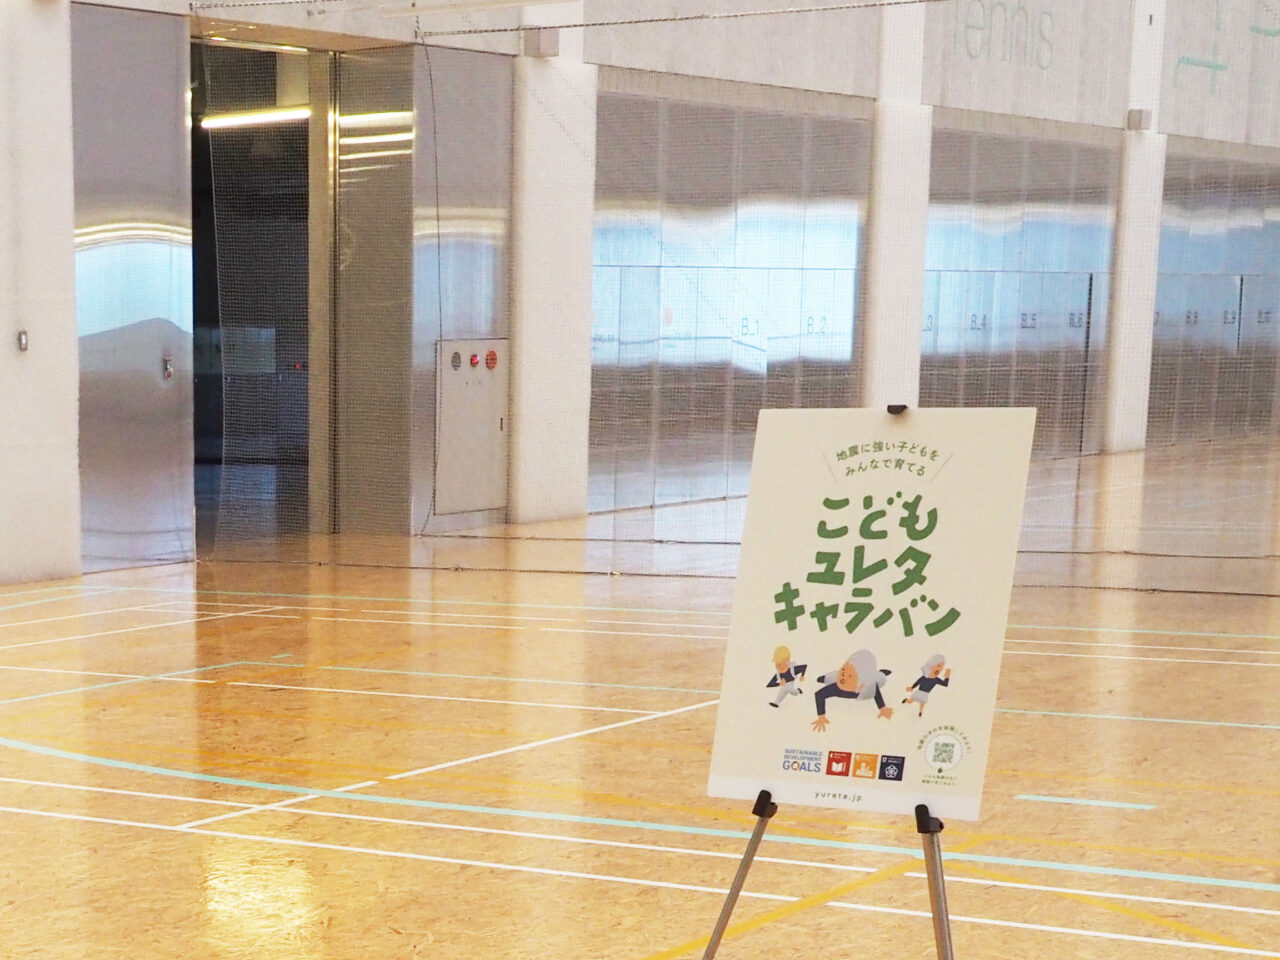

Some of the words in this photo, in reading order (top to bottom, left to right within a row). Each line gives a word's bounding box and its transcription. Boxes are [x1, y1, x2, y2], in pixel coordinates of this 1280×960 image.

[741, 318, 760, 337] B_1
[807, 316, 827, 335] B_2
[836, 440, 941, 462] 地震に強い子どもを
[845, 458, 927, 478] みんなで育てる
[817, 491, 938, 541] こども
[806, 545, 932, 596] ユレタ
[774, 582, 961, 637] キャラバン
[782, 760, 822, 773] GOALS
[814, 790, 863, 803] yureta.jp
